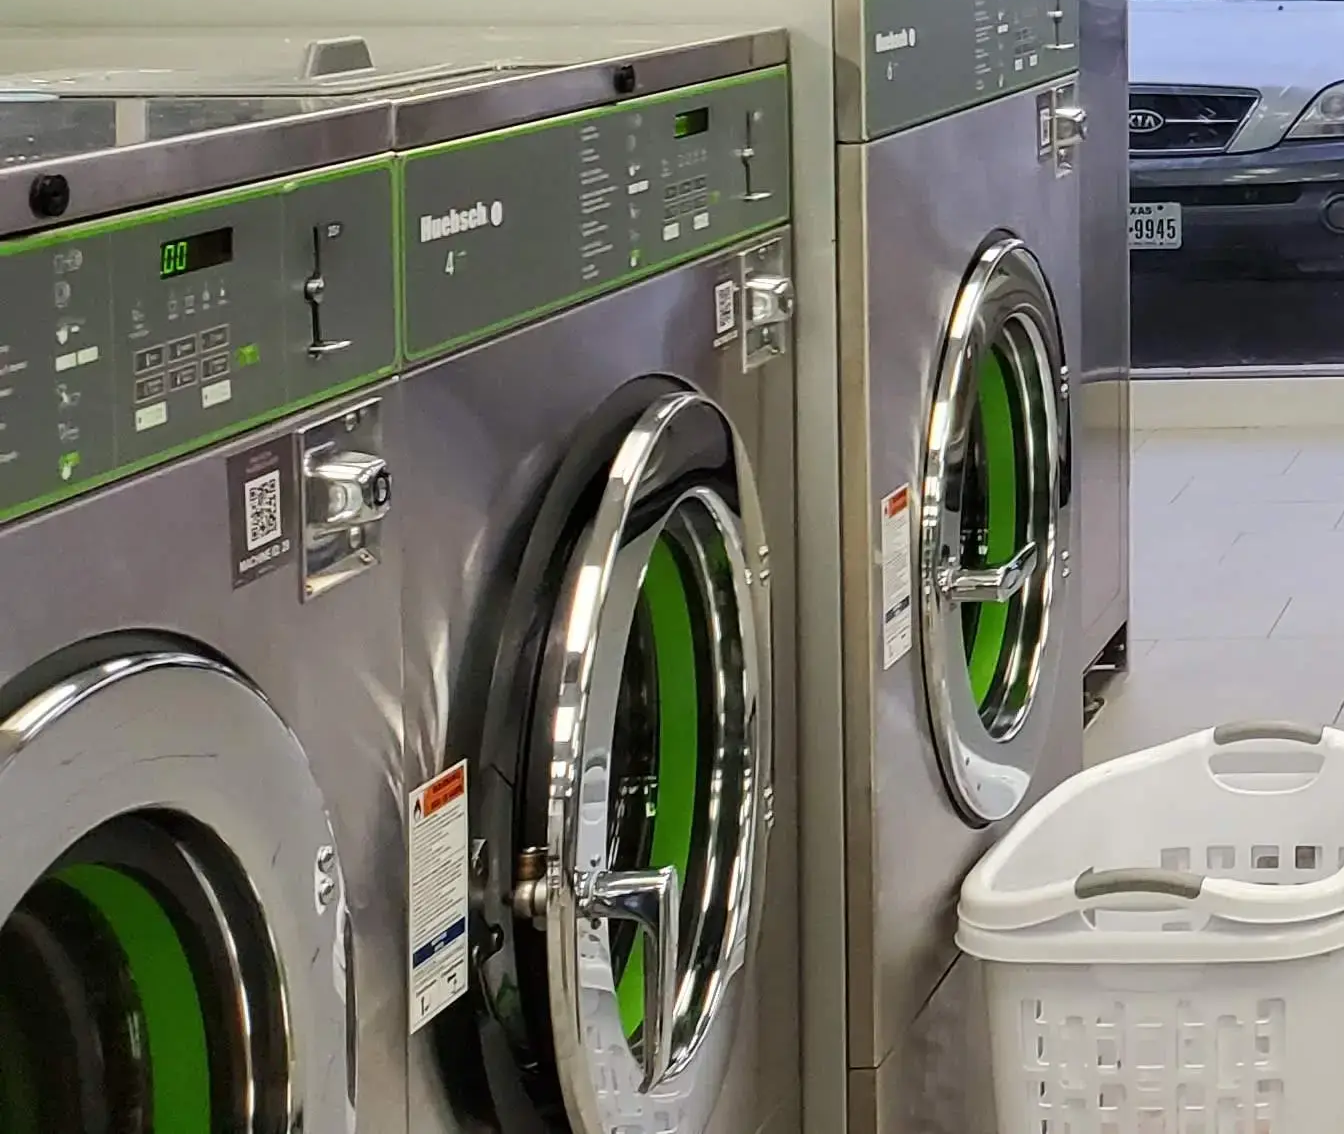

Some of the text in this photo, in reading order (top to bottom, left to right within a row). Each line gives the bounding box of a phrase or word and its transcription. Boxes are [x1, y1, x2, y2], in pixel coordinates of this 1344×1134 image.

[1129, 206, 1153, 215] XAS
[420, 201, 488, 243] Huebsch
[1129, 218, 1176, 240] 9945
